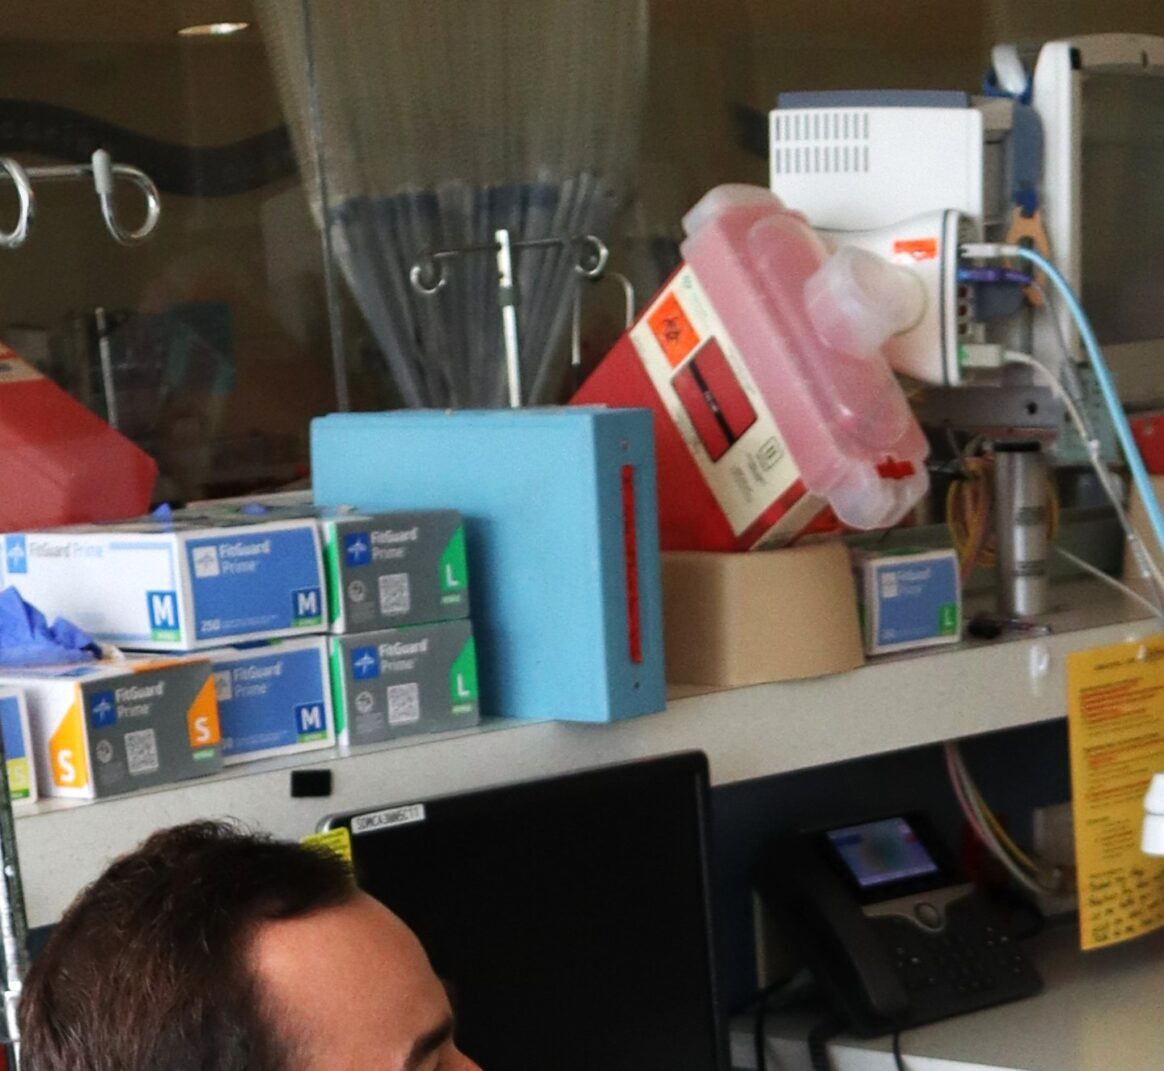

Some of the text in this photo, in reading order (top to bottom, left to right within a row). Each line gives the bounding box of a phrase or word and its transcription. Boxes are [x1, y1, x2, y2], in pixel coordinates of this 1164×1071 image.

[219, 539, 271, 557] FitGuard
[221, 560, 257, 574] Prime
[445, 564, 459, 587] L
[151, 594, 175, 626] M
[297, 591, 317, 615] M
[115, 680, 166, 702] FitGuard
[457, 673, 470, 697] L
[194, 716, 211, 742] S
[300, 705, 321, 731] M
[57, 748, 76, 783] S
